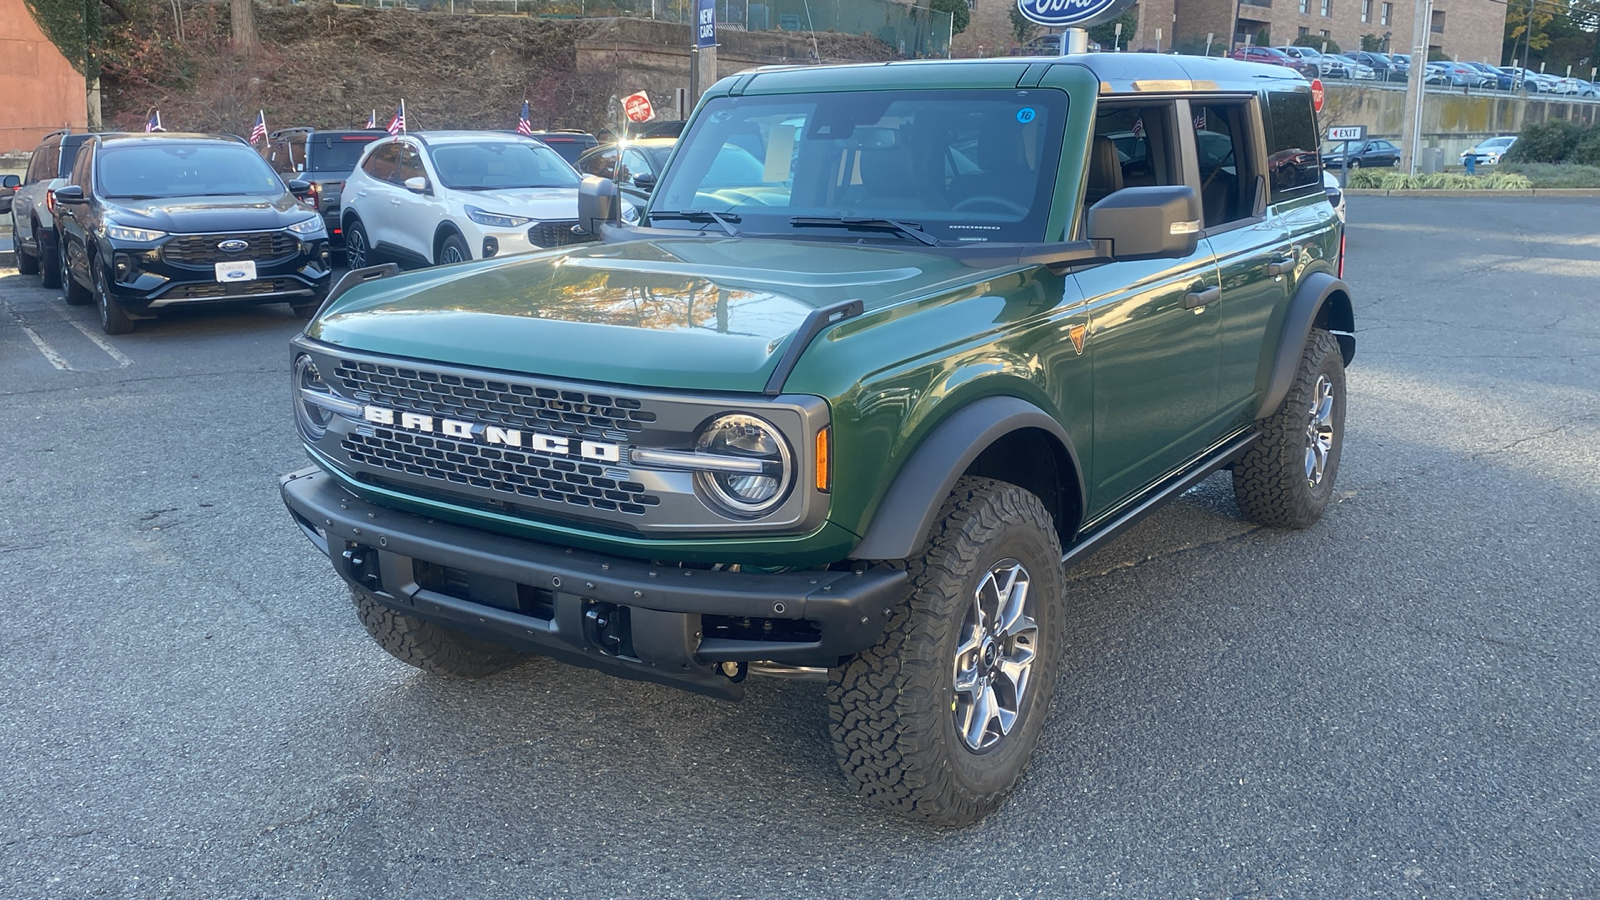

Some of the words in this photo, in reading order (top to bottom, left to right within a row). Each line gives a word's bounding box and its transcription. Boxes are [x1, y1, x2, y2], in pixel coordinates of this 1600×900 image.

[700, 8, 713, 24] NEW
[700, 25, 713, 38] CARS
[1020, 110, 1032, 120] 16
[1339, 129, 1357, 137] EXIT
[364, 404, 620, 462] BRONCO
